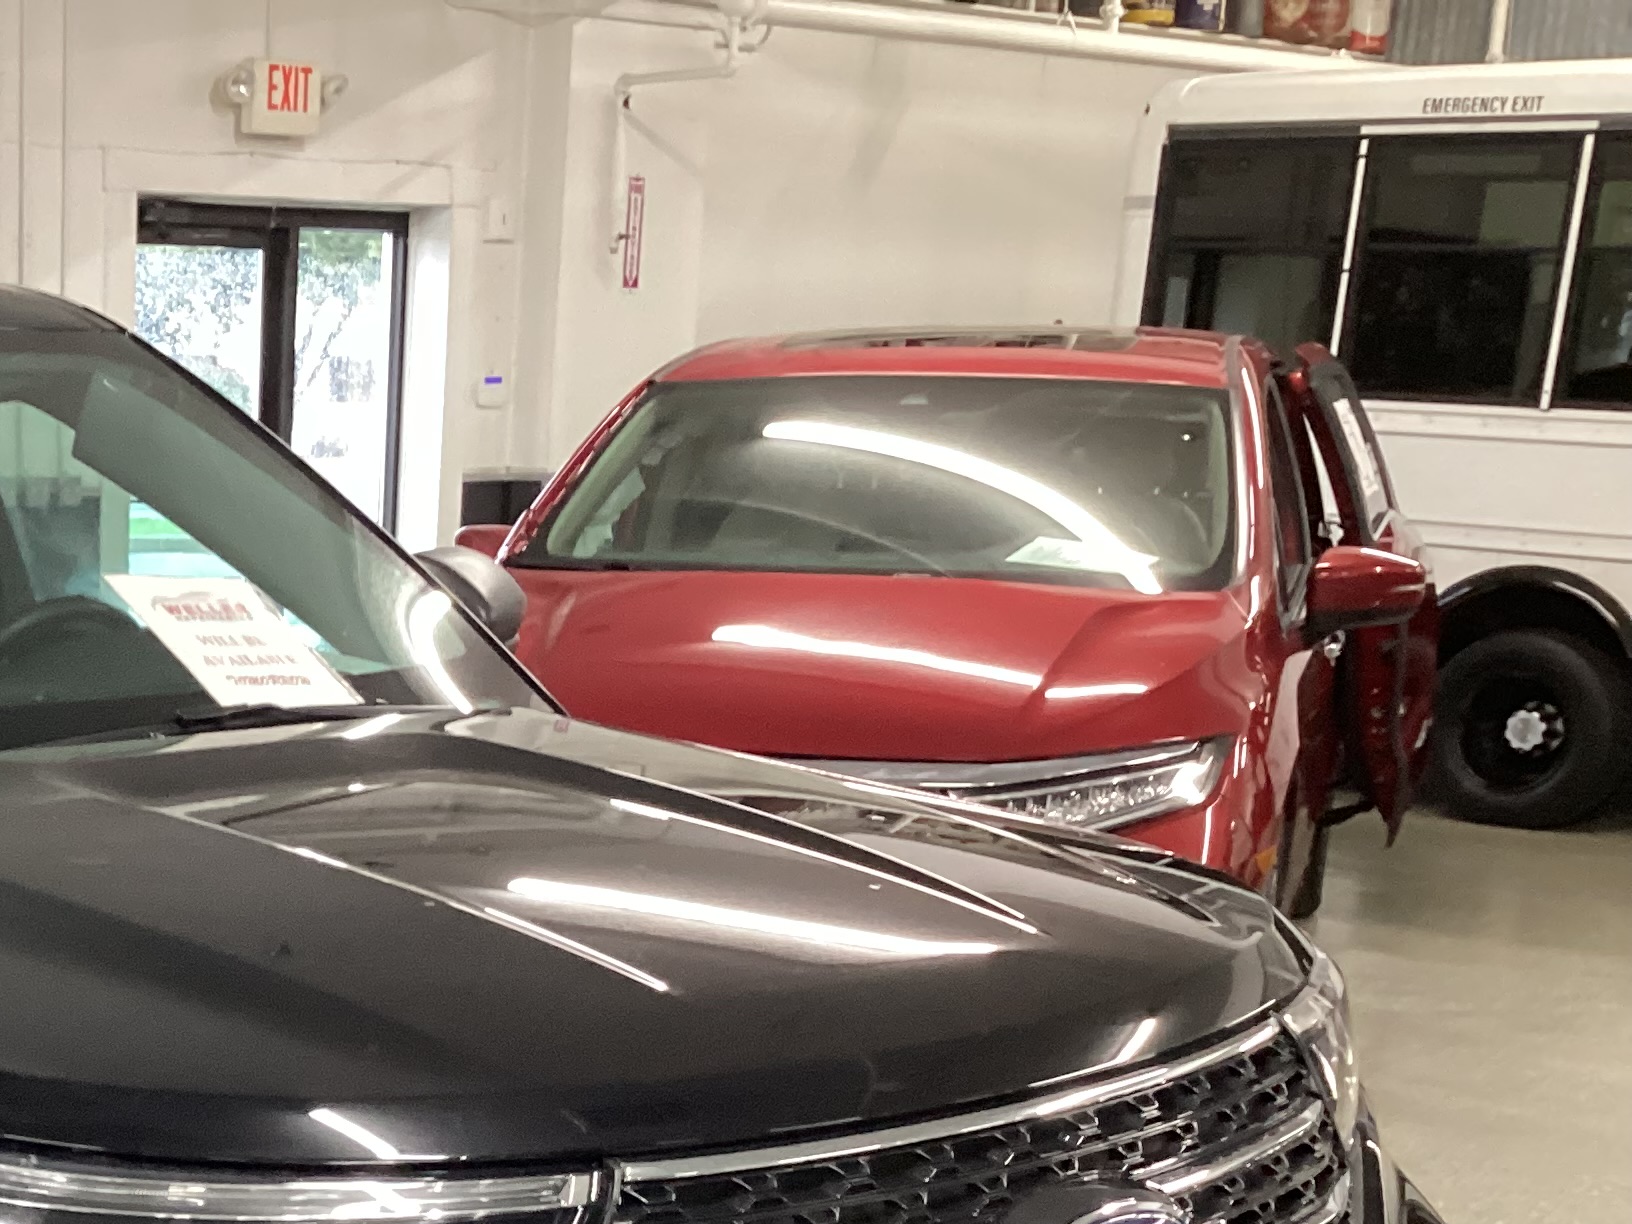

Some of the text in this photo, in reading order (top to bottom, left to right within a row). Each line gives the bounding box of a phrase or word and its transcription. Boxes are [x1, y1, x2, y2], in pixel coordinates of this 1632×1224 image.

[268, 64, 313, 113] EXIT
[1422, 95, 1545, 115] EMERGENCY EXIT
